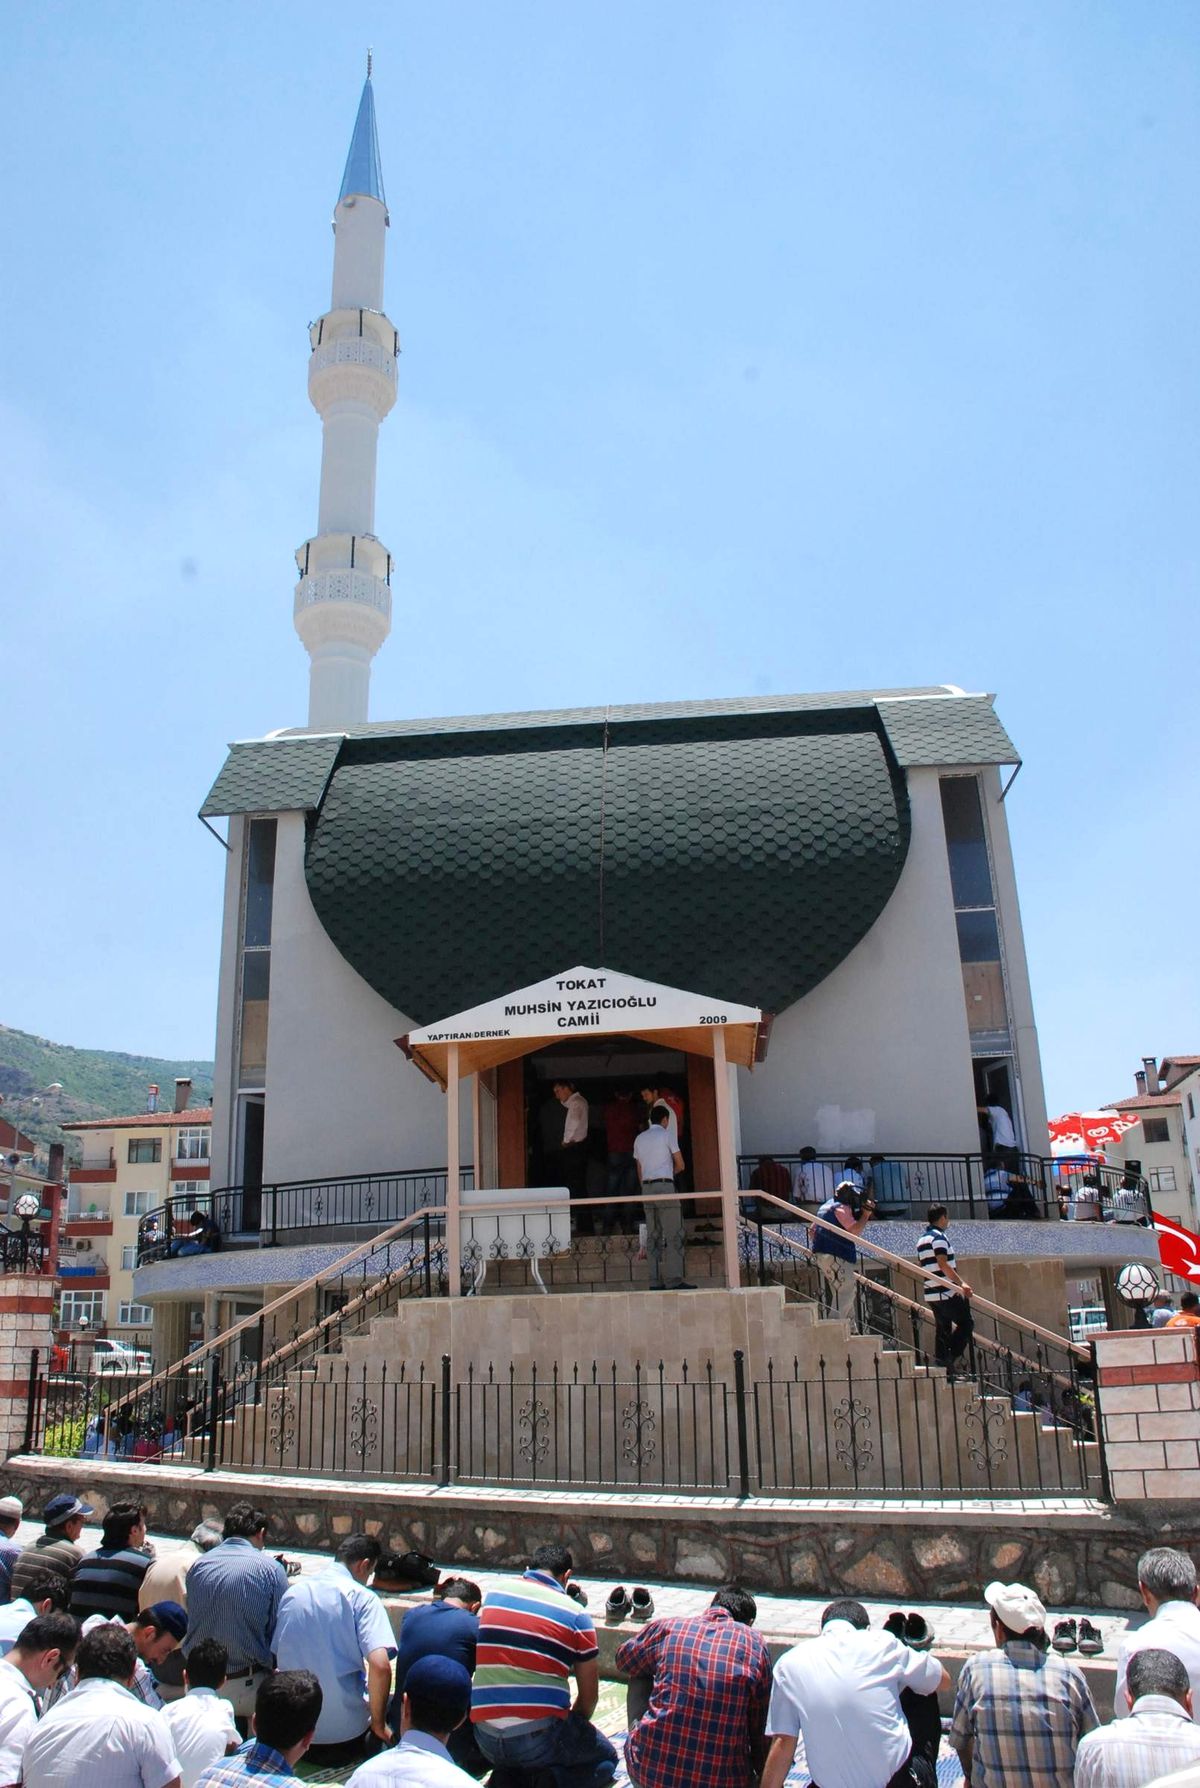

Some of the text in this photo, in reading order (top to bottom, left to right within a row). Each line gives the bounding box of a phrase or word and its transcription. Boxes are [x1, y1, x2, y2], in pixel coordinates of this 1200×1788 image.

[556, 978, 607, 991] TOKAT
[504, 996, 657, 1016] MUHSİN YAZICIOĞLU
[557, 1012, 600, 1028] CAMİİ
[699, 1015, 728, 1025] 2009
[474, 1029, 511, 1038] DERNEK
